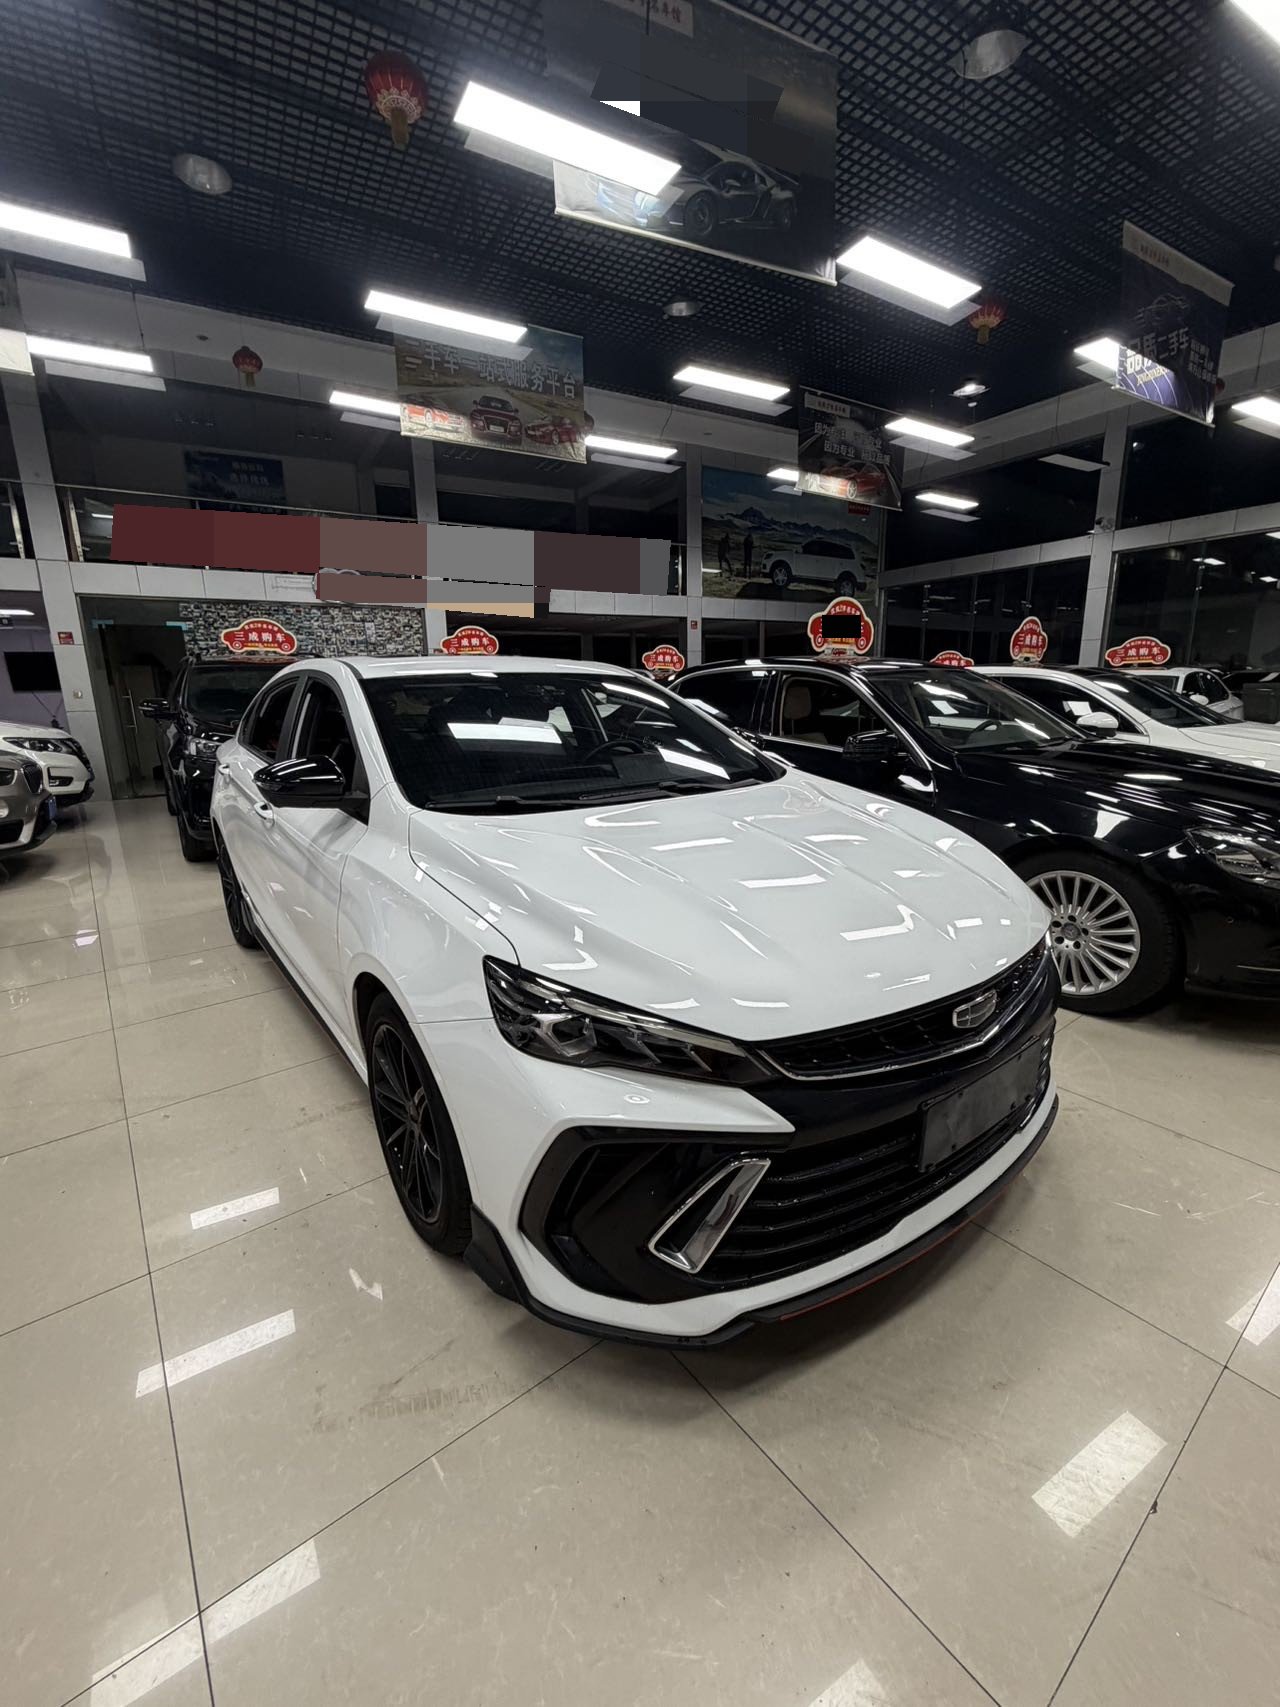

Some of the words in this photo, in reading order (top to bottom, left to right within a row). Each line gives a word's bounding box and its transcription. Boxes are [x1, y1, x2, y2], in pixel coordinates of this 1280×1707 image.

[404, 339, 576, 399] 二手车一站式服务平台
[234, 631, 286, 643] 三成购车
